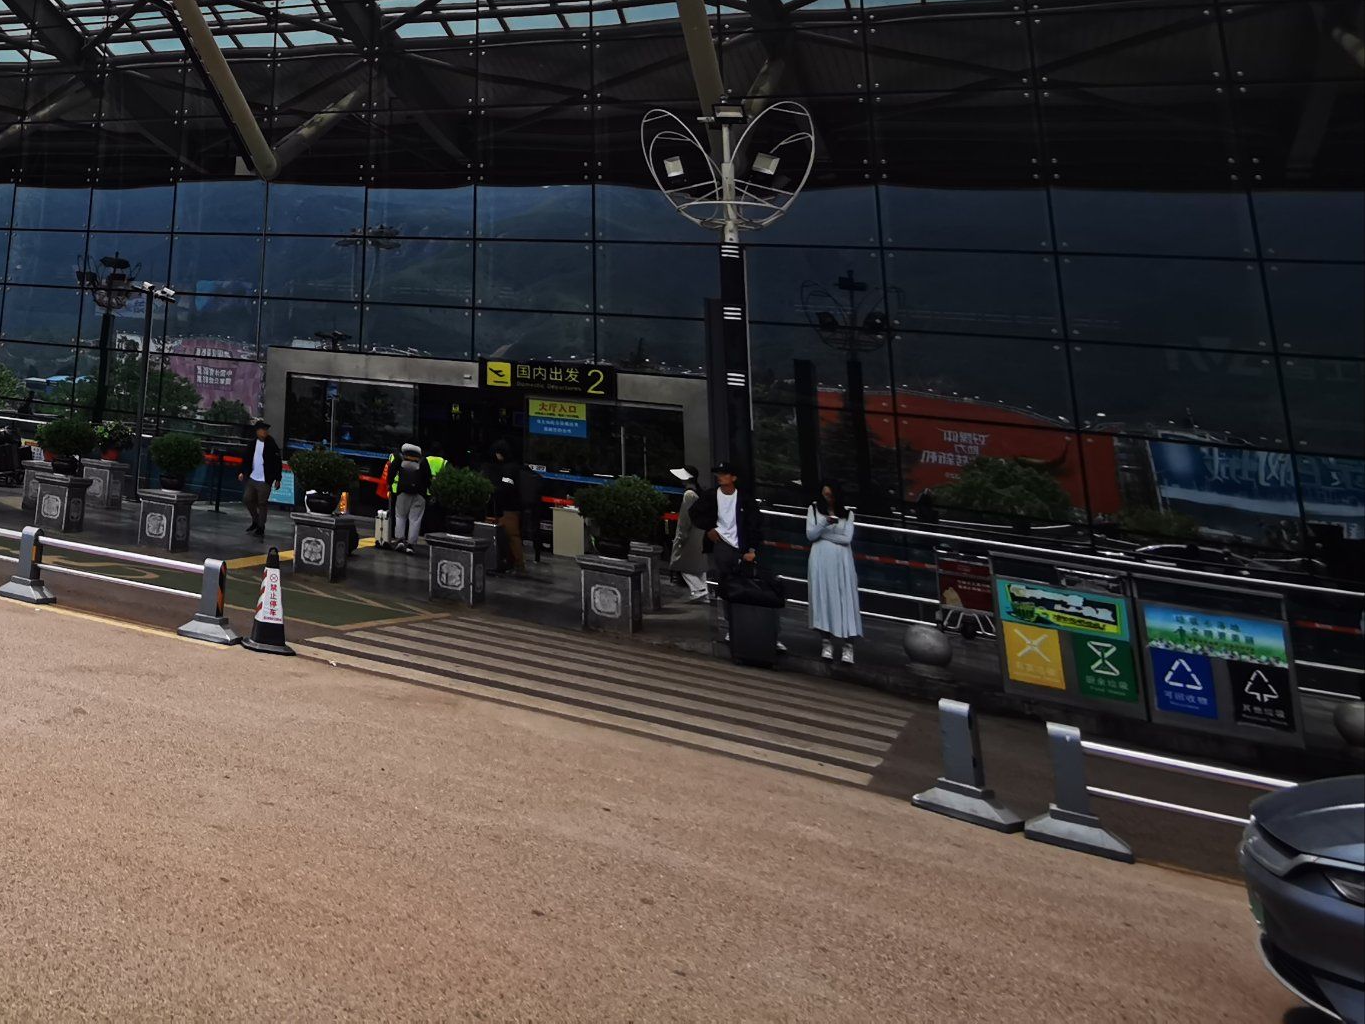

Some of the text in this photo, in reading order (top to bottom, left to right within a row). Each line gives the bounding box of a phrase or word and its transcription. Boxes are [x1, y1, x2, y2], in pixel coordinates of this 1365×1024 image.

[516, 364, 605, 395] 国内出发 2
[538, 402, 577, 413] 大厅入口
[1163, 689, 1208, 705] 可回收物
